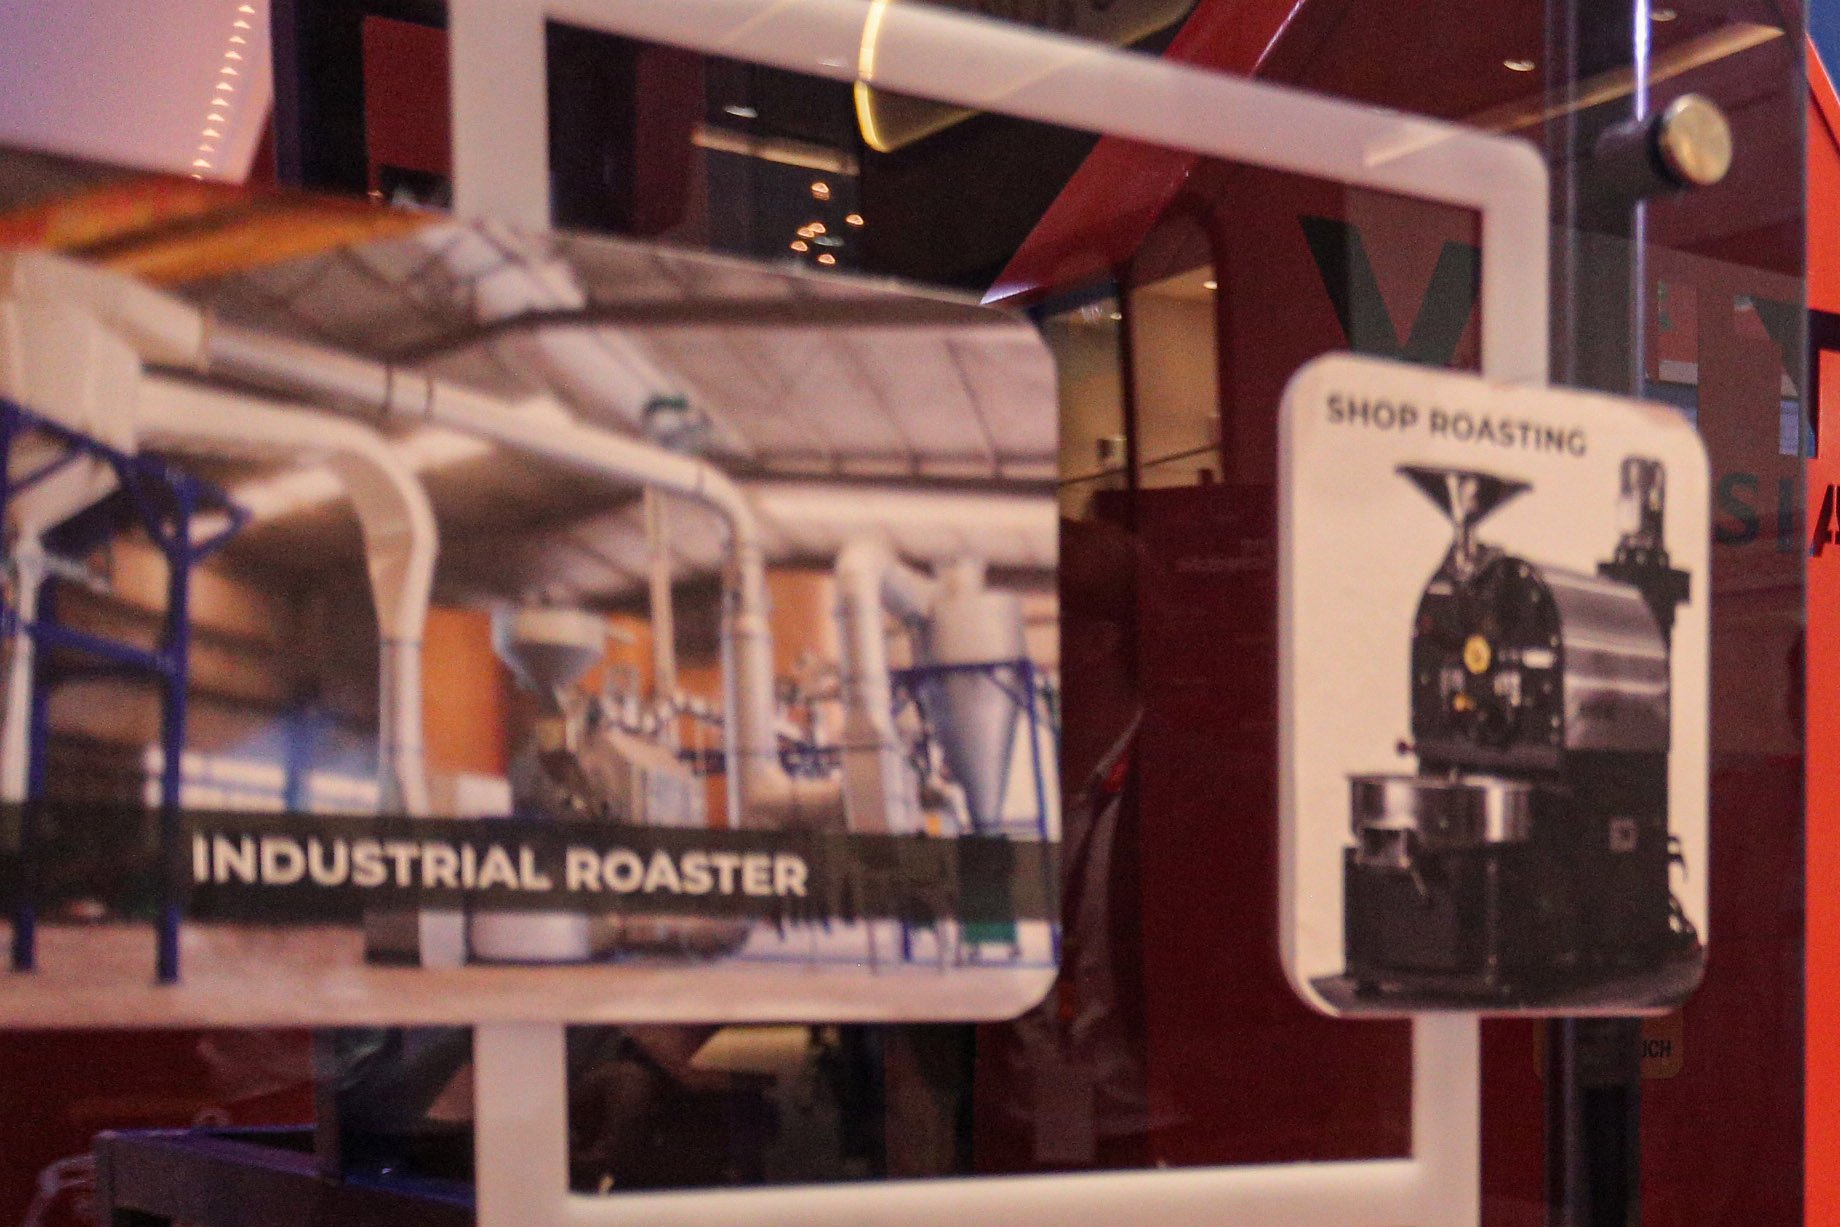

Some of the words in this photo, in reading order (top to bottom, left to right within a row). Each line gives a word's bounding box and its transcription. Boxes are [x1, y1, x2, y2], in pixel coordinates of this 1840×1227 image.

[1326, 394, 1419, 434] SHOP
[1431, 410, 1588, 458] ROASTING
[192, 834, 551, 892] INDUSTRIAL
[566, 843, 808, 898] ROASTER
